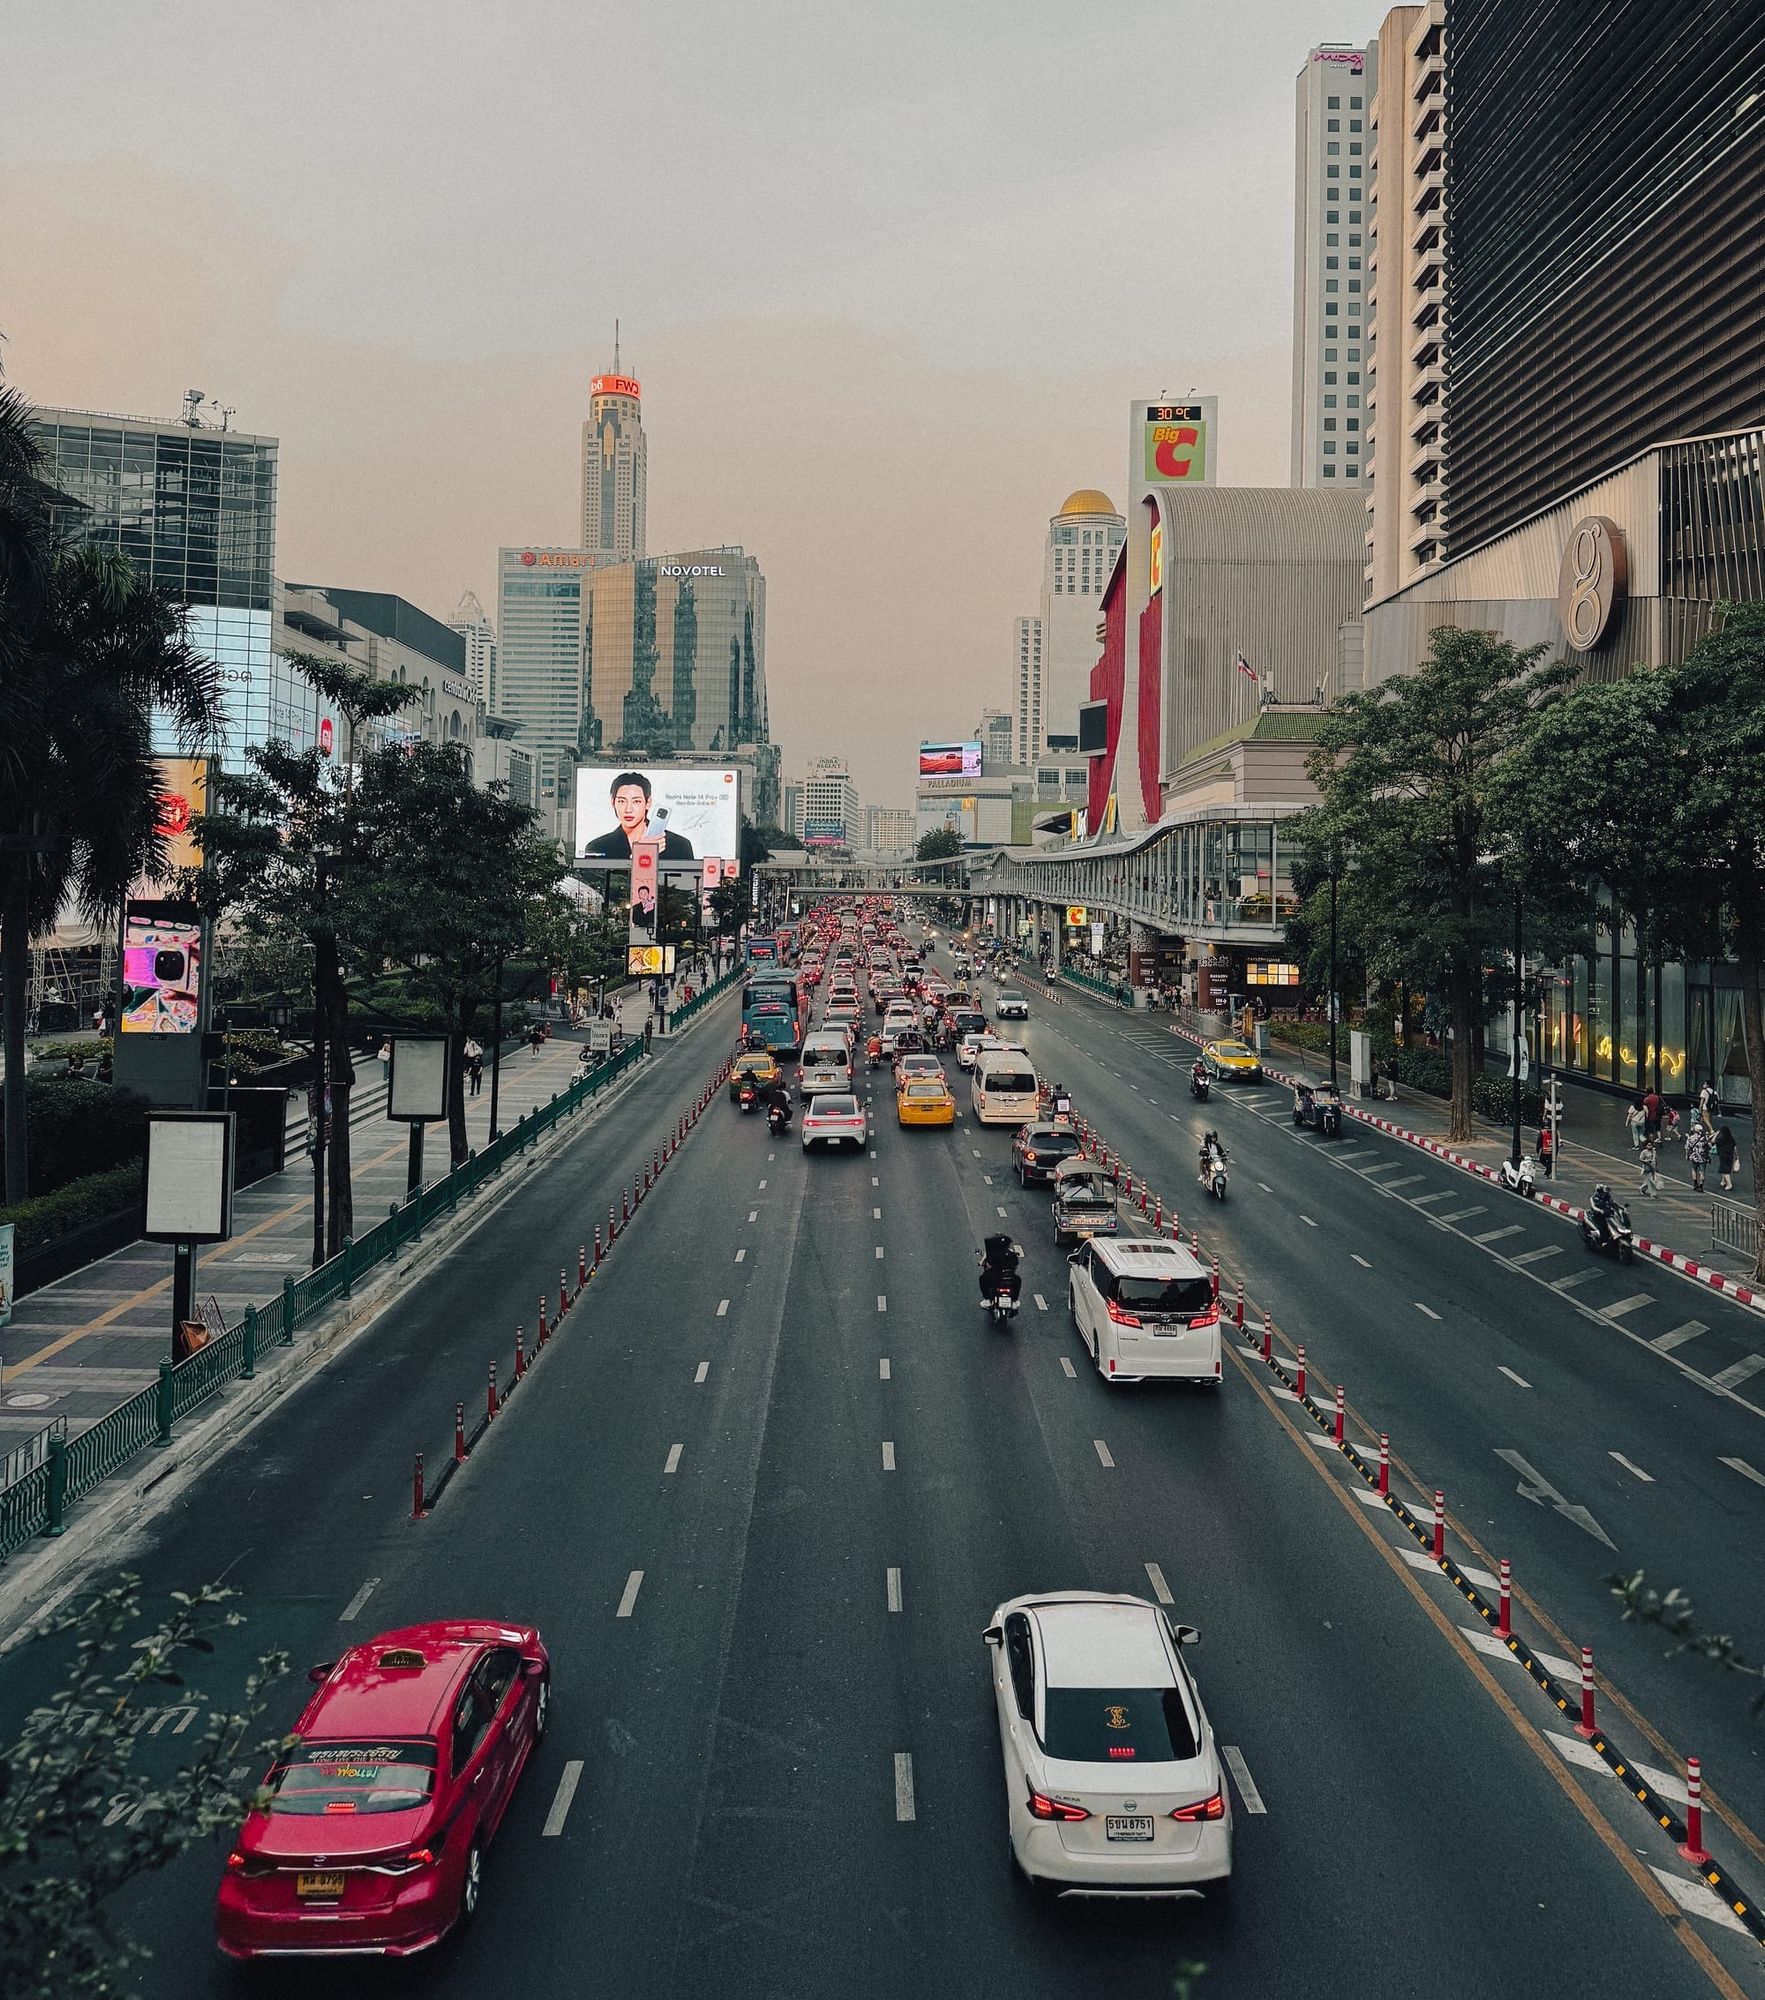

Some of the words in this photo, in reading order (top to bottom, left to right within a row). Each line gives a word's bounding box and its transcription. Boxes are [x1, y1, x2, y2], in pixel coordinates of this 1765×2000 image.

[615, 379, 639, 395] FWD
[1157, 407, 1173, 420] 30
[1152, 426, 1180, 444] Big
[1154, 426, 1199, 478] C
[539, 551, 595, 567] Amari
[660, 565, 726, 577] NOVOTEL
[927, 779, 972, 789] PALLADIUM
[1129, 1819, 1151, 1829] 8751
